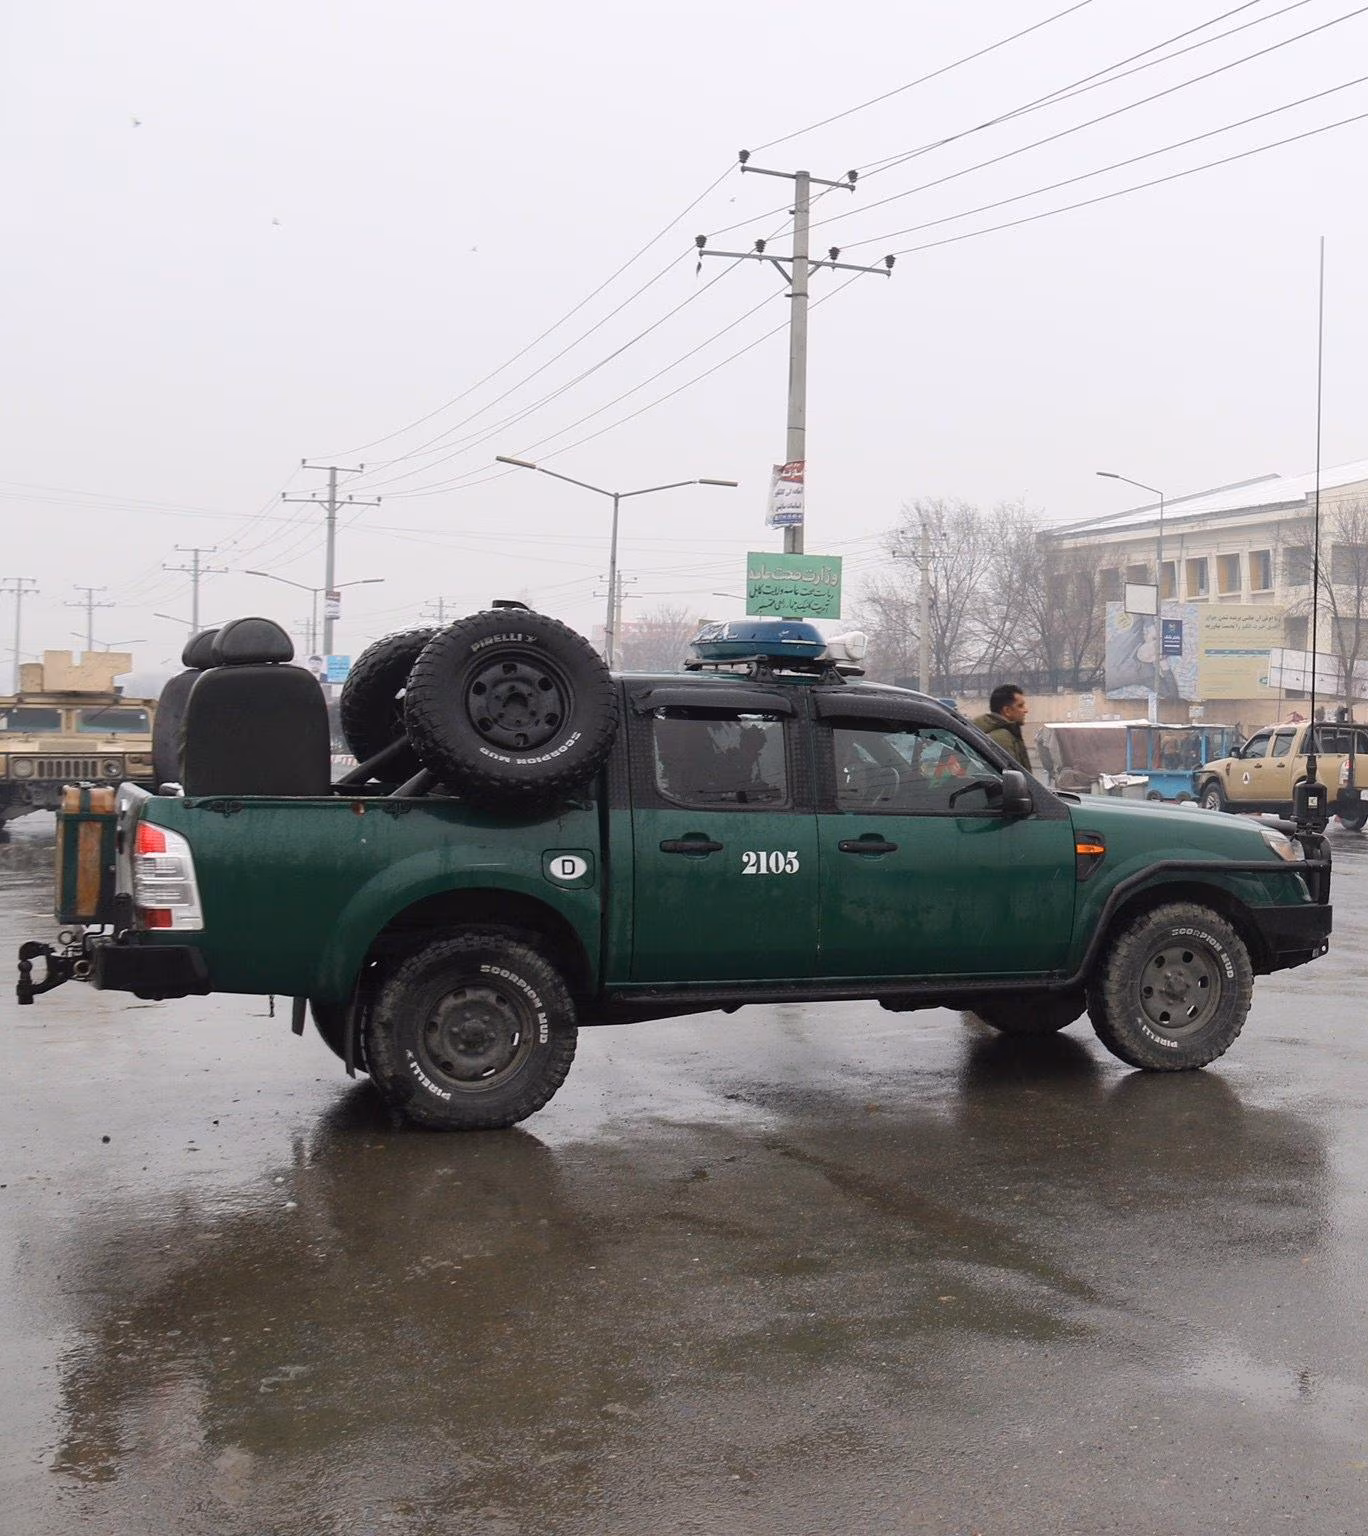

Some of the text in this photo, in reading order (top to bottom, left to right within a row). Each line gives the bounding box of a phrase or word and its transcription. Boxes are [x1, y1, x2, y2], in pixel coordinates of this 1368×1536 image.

[801, 565, 839, 587] وزارت
[470, 633, 522, 653] PIRELLI
[479, 731, 582, 765] SCORPION MUD
[561, 859, 576, 875] D
[741, 850, 800, 875] 2105
[1171, 928, 1235, 979] SCORPION MUD
[480, 964, 549, 1044] SCORPION MUD
[1142, 1025, 1178, 1047] PIRELLI
[409, 1061, 452, 1100] PIRELLI
